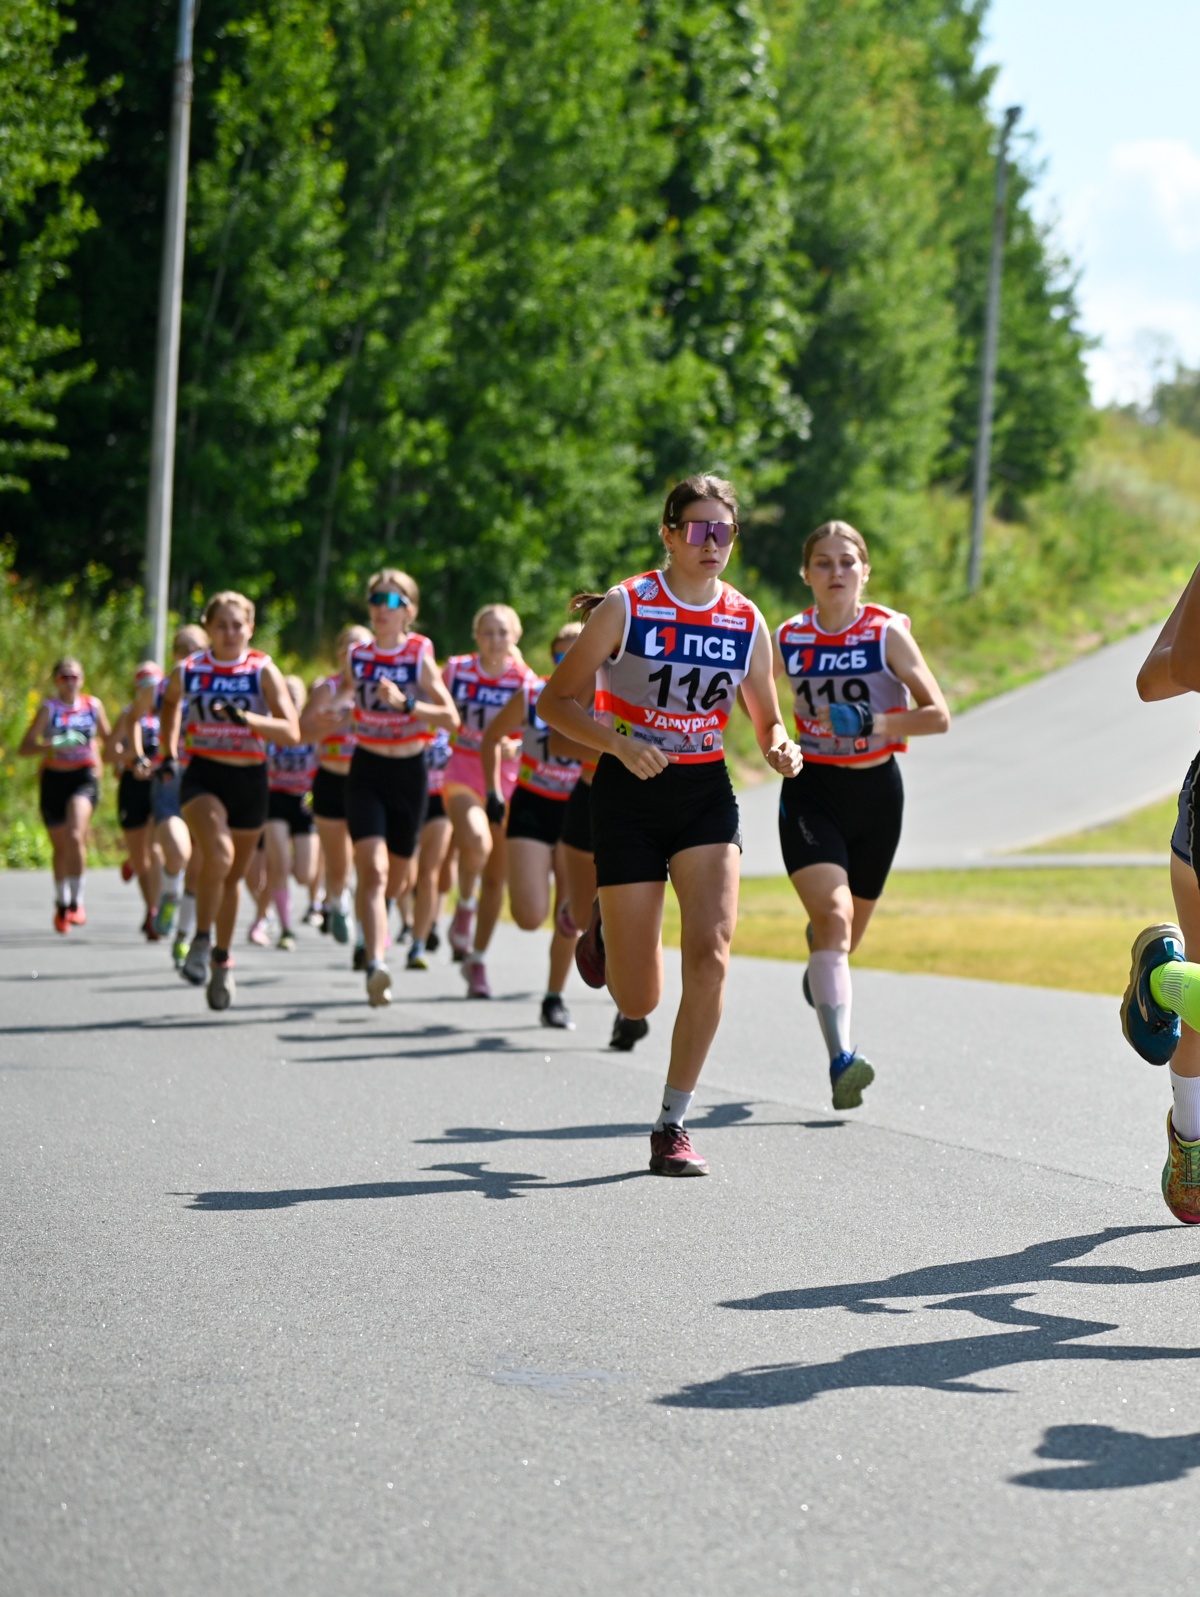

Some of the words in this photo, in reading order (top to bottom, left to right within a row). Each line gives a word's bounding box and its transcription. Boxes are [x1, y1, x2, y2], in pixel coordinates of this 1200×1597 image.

[683, 634, 737, 661] ПСБ
[818, 650, 867, 671] ПСБ
[648, 664, 733, 712] 116
[796, 678, 870, 717] 119
